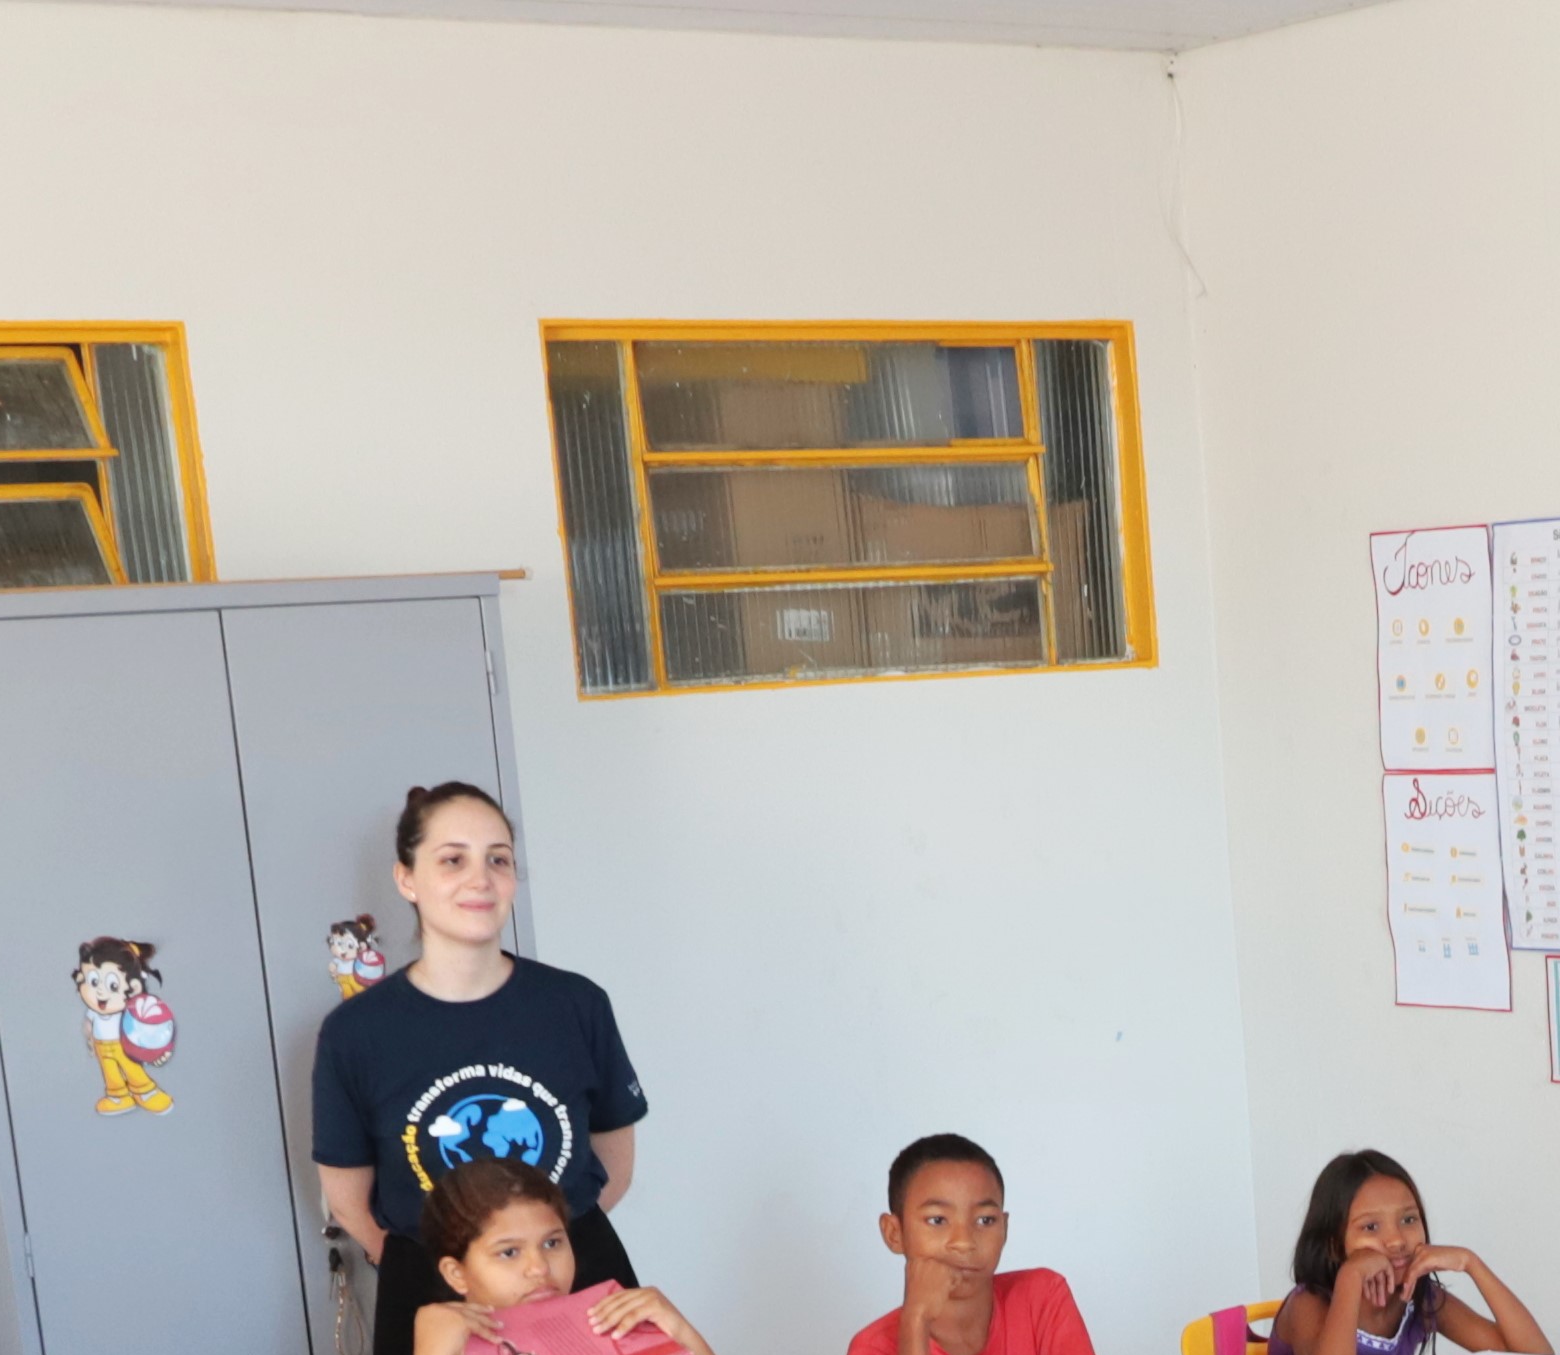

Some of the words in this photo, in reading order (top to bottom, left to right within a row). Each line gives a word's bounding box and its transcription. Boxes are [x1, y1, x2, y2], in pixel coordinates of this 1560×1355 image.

[407, 1062, 487, 1124] transforma
[487, 1062, 532, 1089] vidas
[531, 1080, 559, 1108] que
